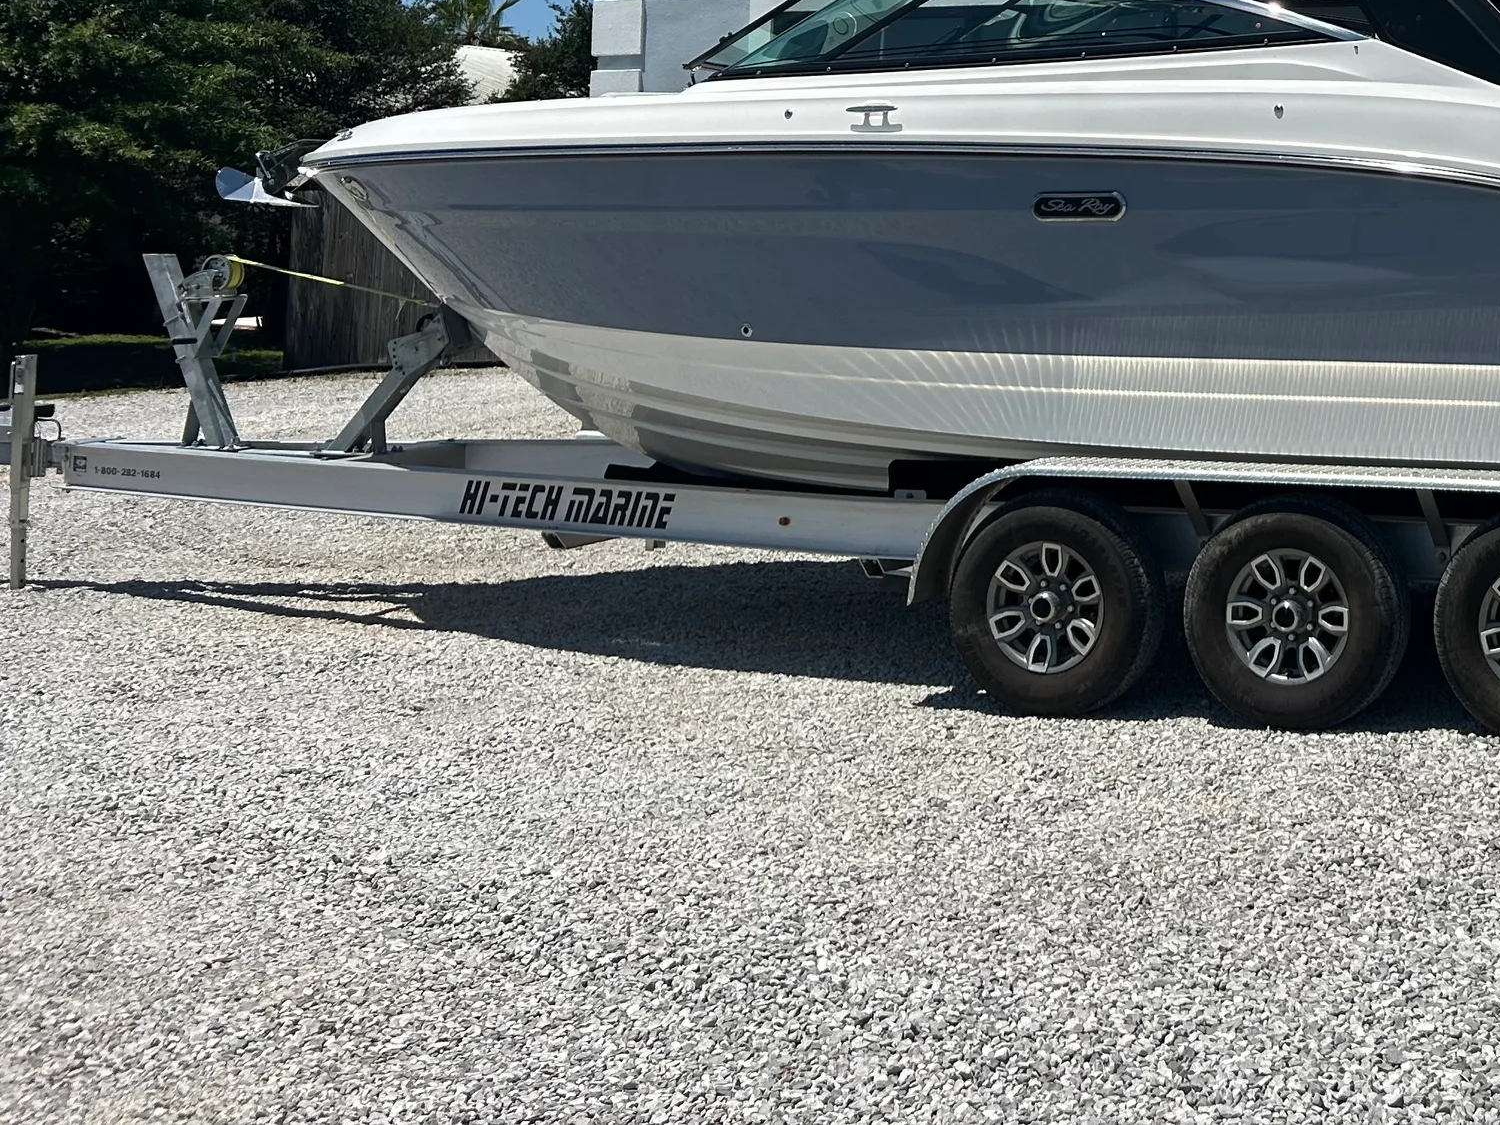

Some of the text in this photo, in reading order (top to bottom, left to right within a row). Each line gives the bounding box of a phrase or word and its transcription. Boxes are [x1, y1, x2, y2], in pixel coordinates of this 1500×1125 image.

[1041, 197, 1115, 215] Sea Ray
[458, 479, 676, 530] HI-TECH MARINE
